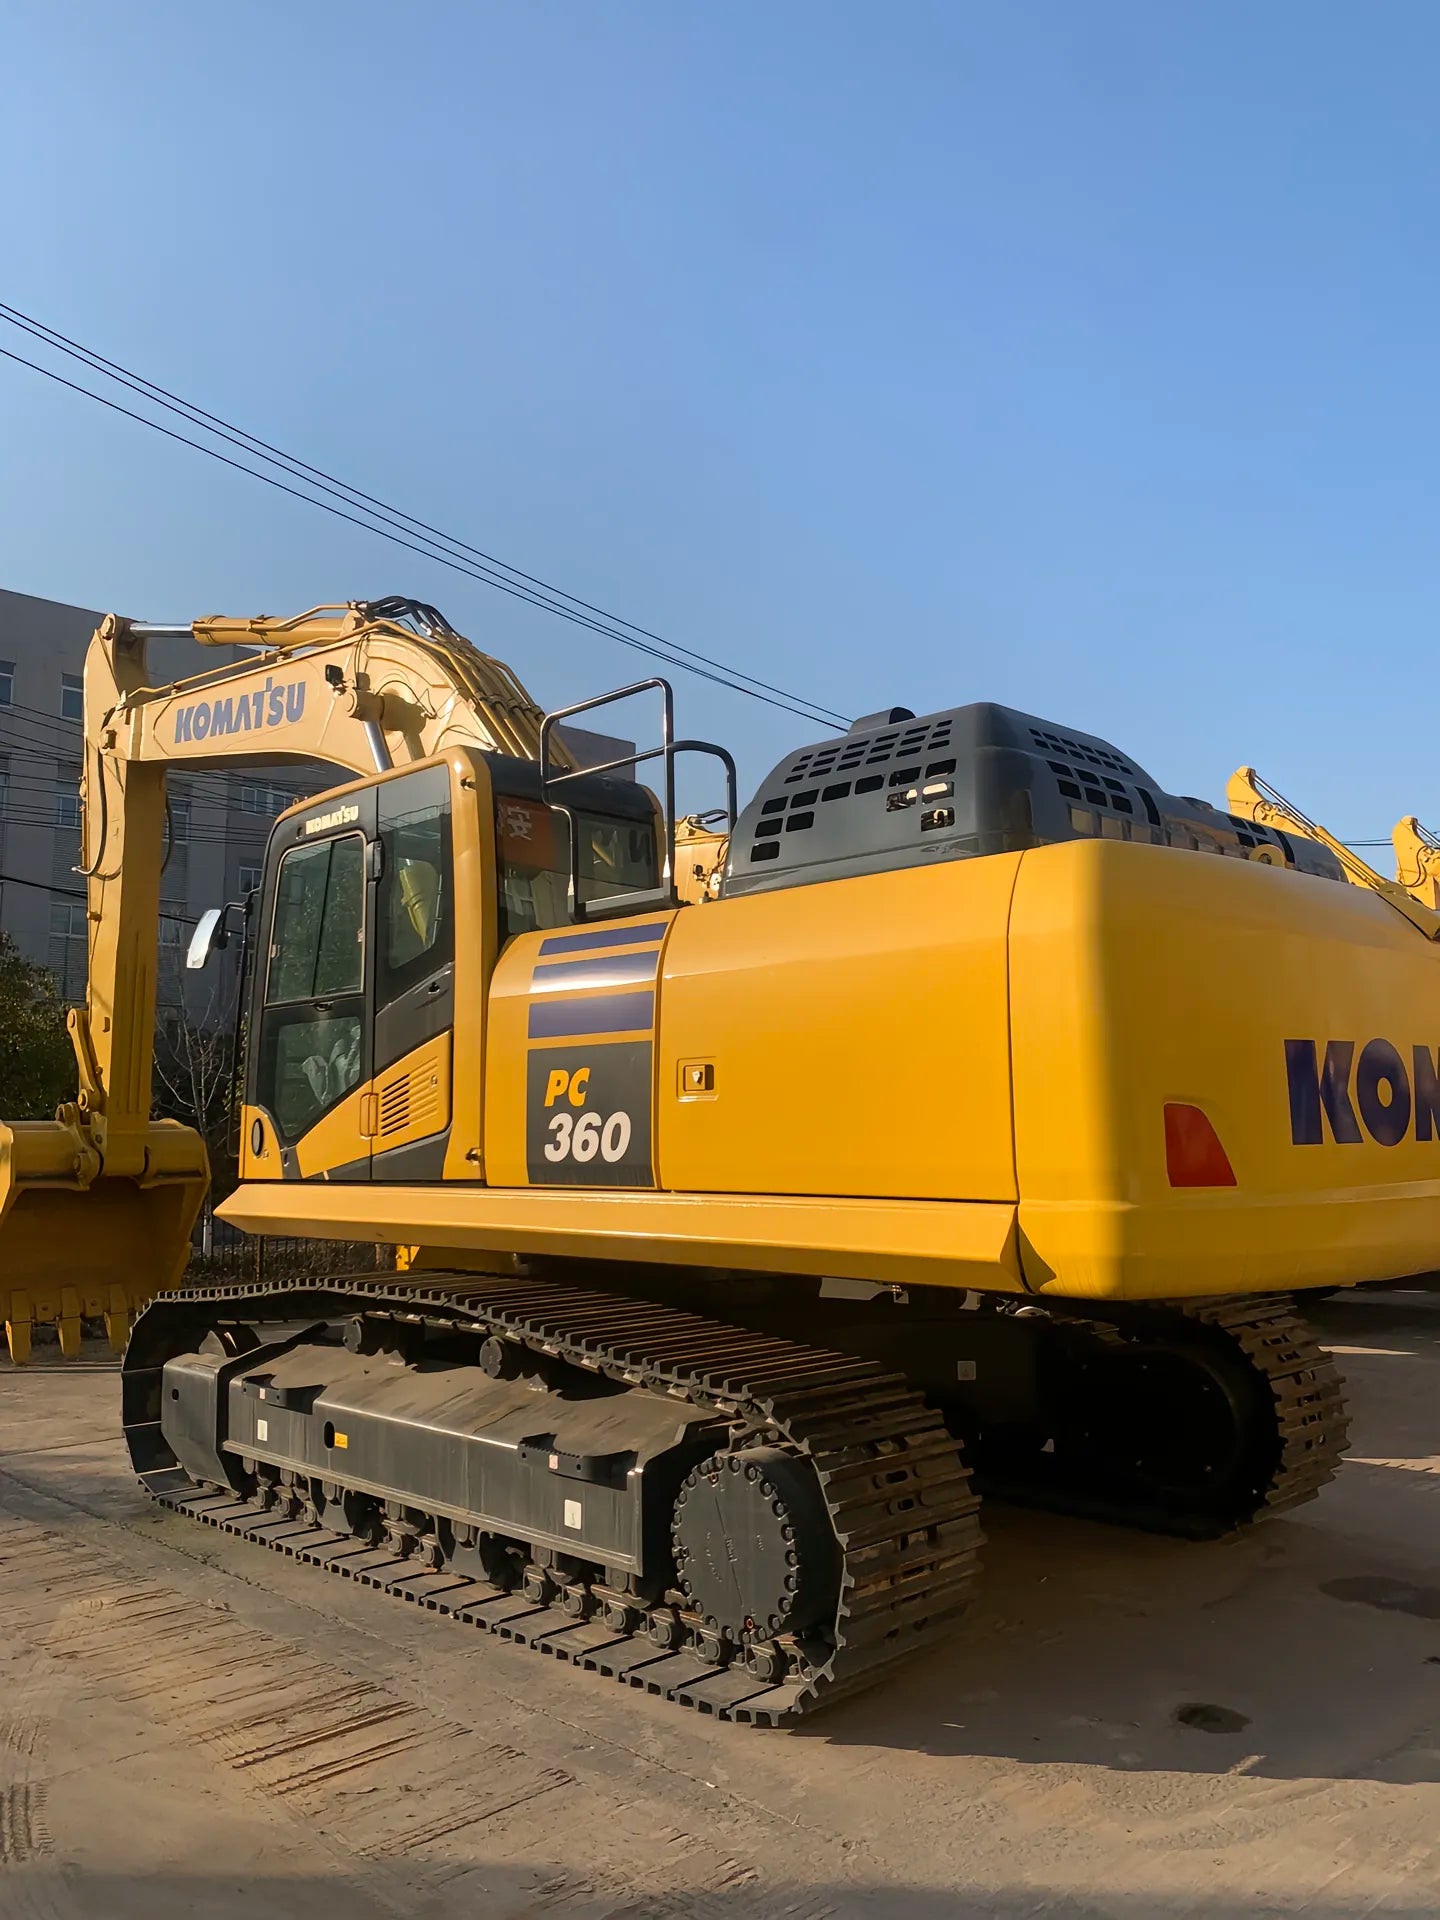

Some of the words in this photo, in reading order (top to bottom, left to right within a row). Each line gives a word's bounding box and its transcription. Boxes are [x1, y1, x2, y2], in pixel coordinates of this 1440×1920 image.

[174, 676, 306, 744] KOMATSU
[543, 1067, 591, 1108] PC
[544, 1111, 632, 1163] 360
